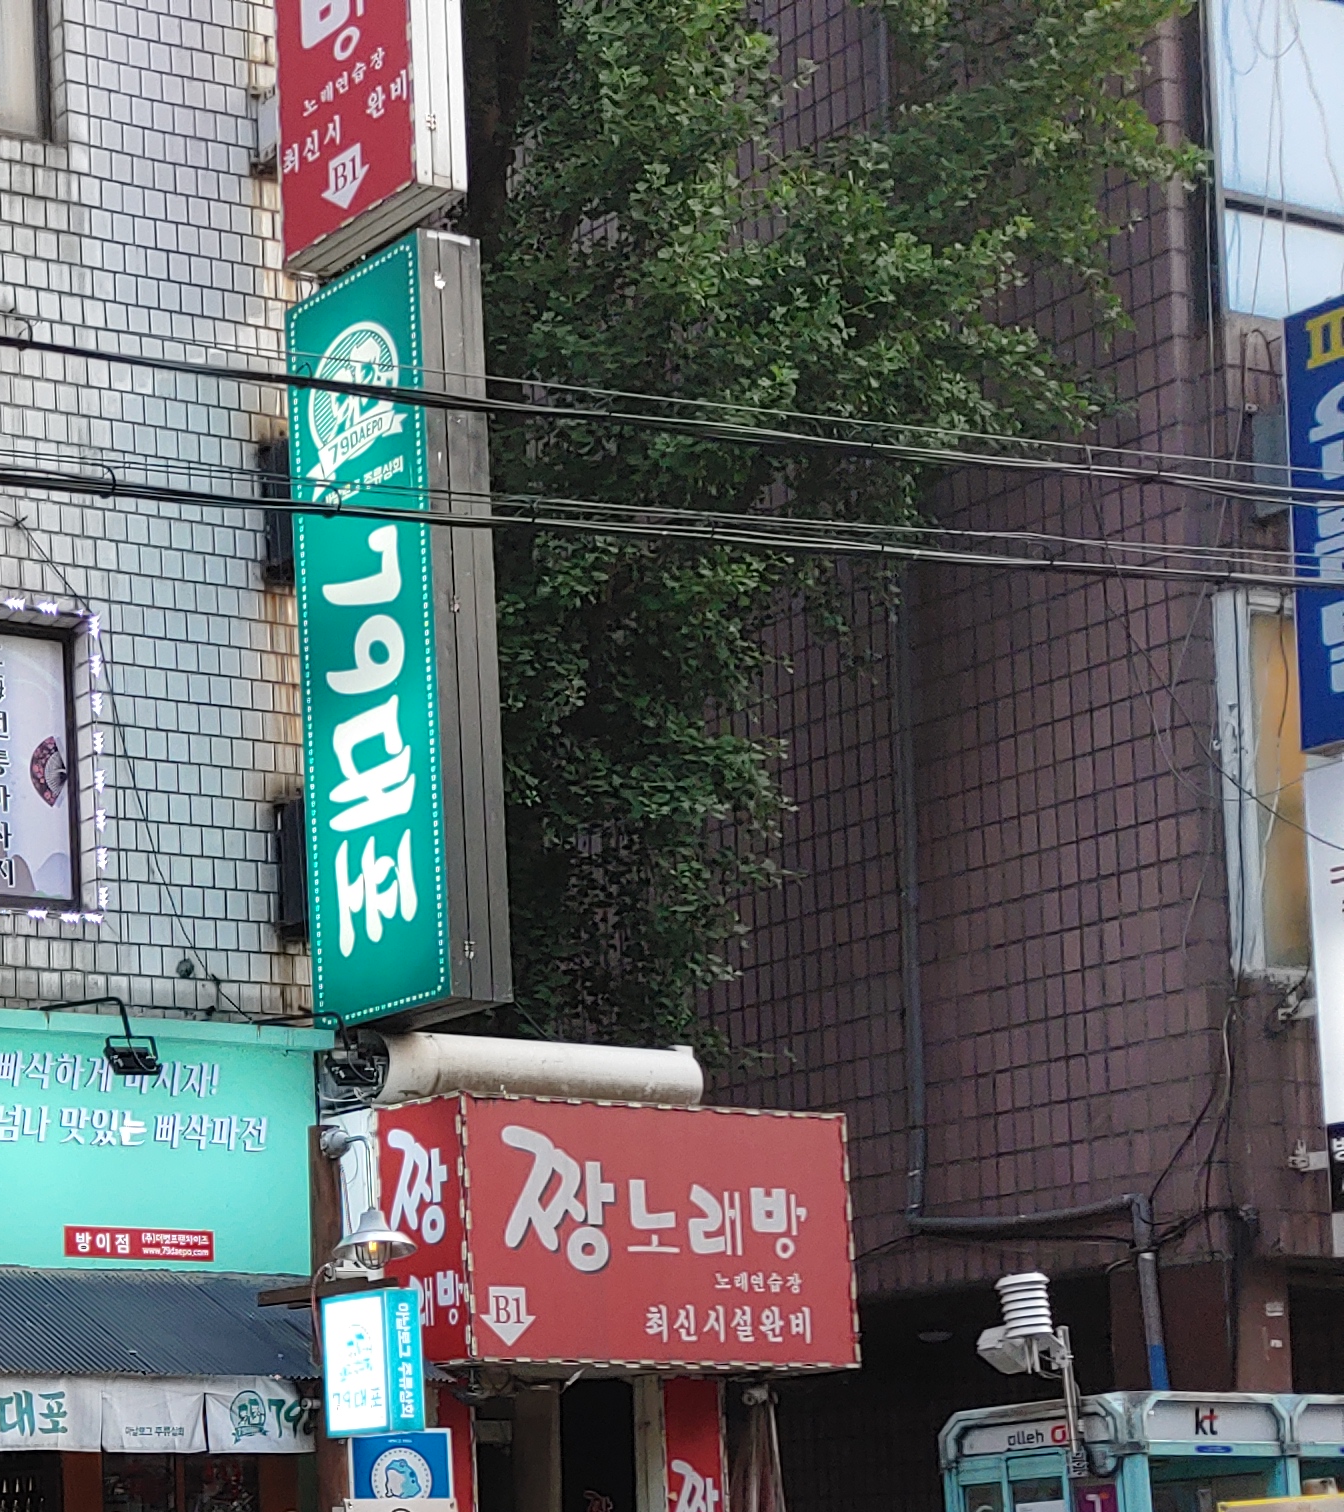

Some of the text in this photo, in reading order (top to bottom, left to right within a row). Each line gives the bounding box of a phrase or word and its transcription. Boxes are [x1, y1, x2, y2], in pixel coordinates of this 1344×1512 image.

[332, 152, 359, 195] B1
[328, 417, 383, 464] 79DAEPO
[320, 524, 418, 958] 79대포
[60, 1108, 147, 1148] 맛있는
[154, 1115, 267, 1153] 빠삭파전
[492, 1293, 528, 1326] B1
[1008, 1429, 1044, 1447] olleh
[1195, 1407, 1218, 1435] kt
